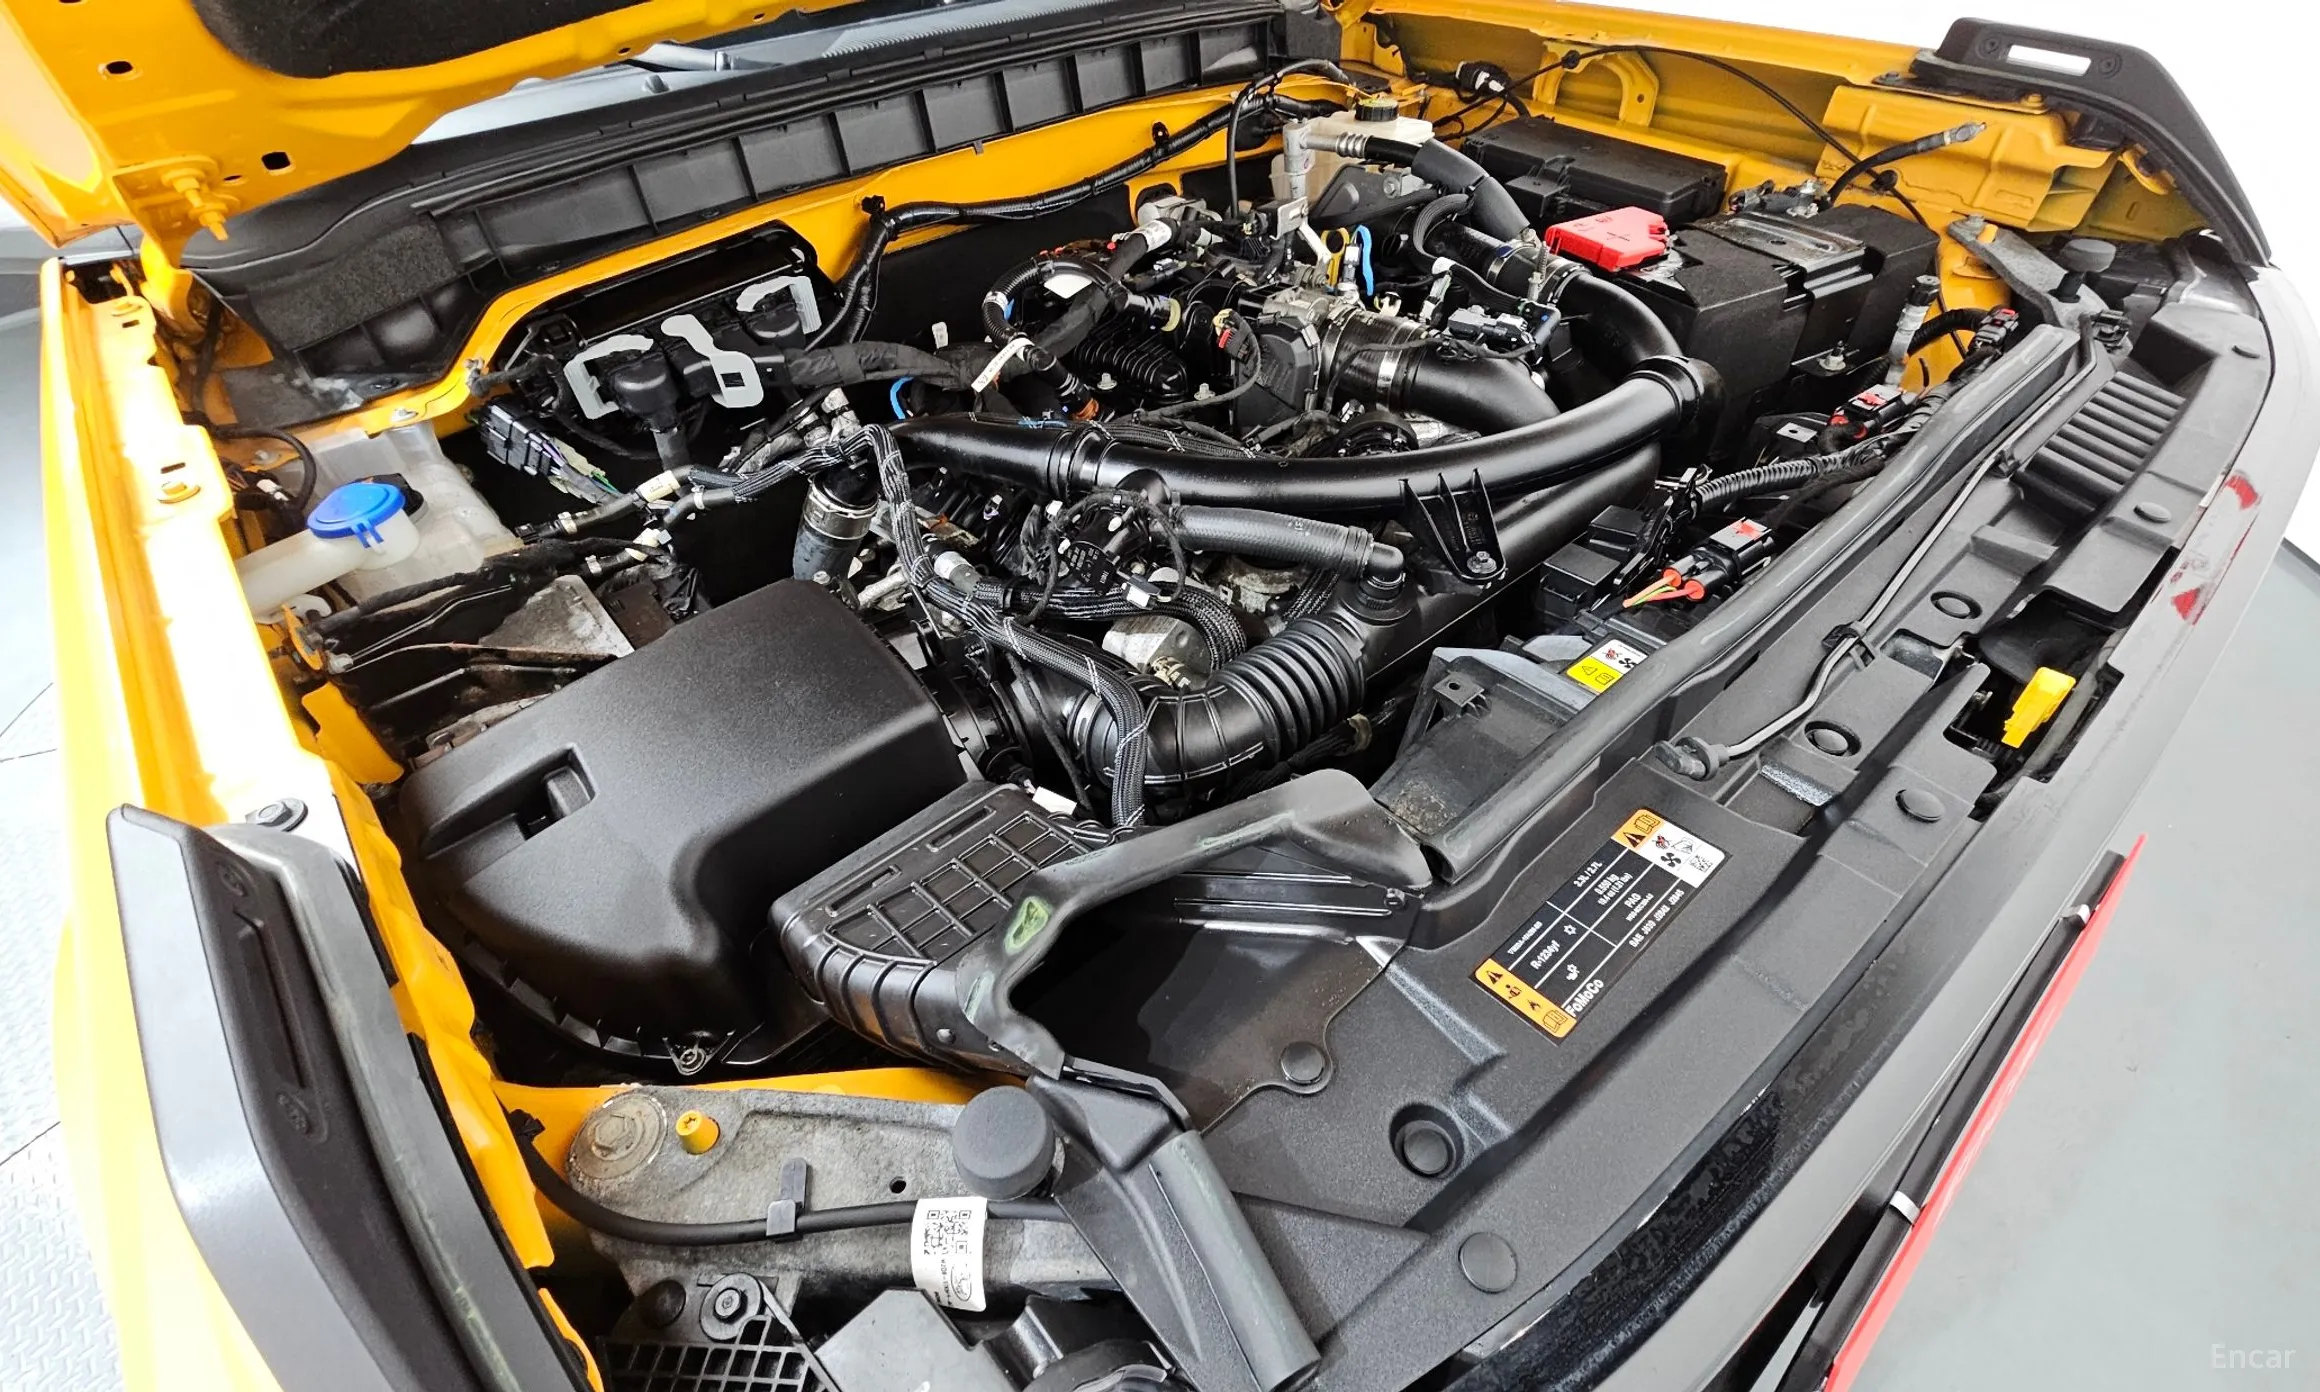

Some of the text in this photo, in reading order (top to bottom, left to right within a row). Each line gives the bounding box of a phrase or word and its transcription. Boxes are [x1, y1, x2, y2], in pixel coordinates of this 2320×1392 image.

[1574, 875, 1589, 887] 2.3L
[1587, 862, 1602, 874] 2.7L
[1624, 893, 1641, 908] PAG
[1629, 933, 1644, 947] SAE
[1530, 940, 1560, 969] R-1234yf
[1565, 980, 1604, 1017] FoMoCo
